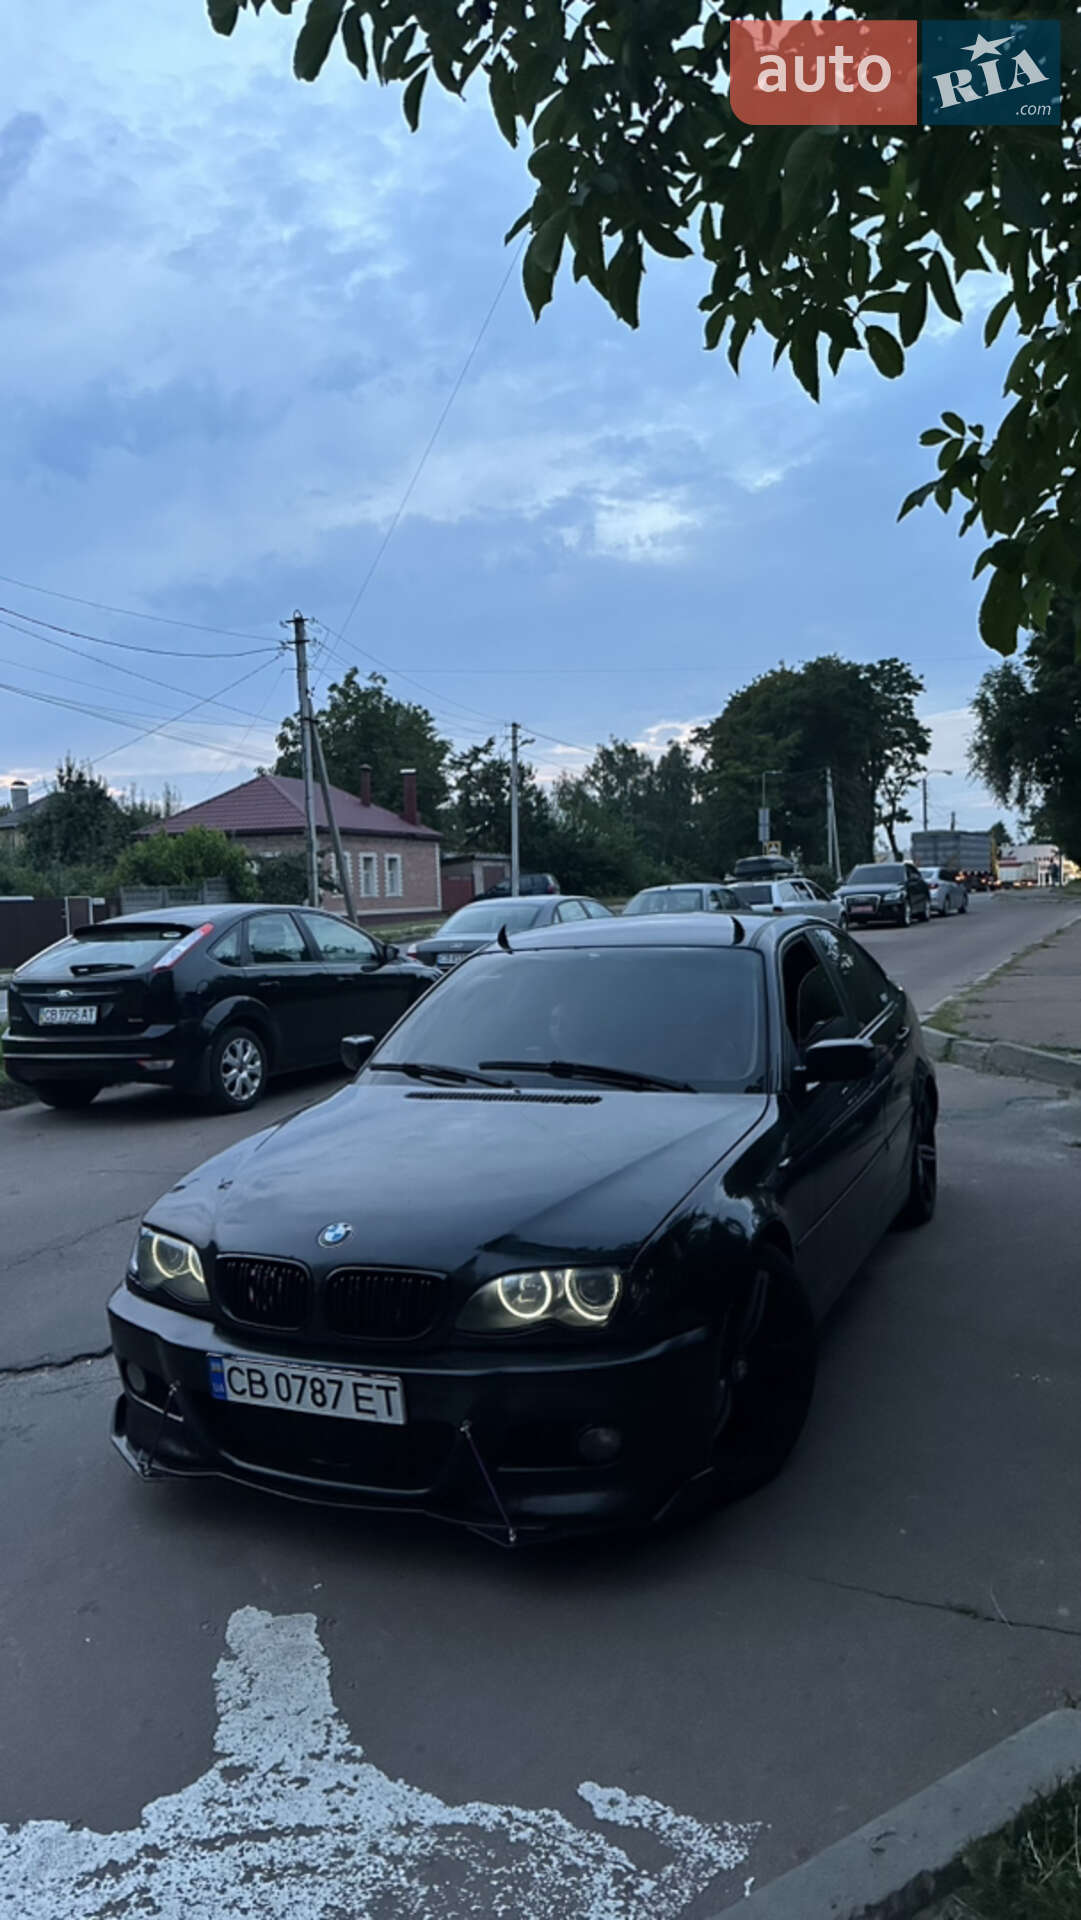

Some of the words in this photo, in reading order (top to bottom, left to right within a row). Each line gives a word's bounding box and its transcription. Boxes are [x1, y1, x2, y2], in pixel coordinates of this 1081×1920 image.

[227, 1366, 268, 1399] CB
[275, 1372, 343, 1410] 0787
[352, 1382, 398, 1417] ET
